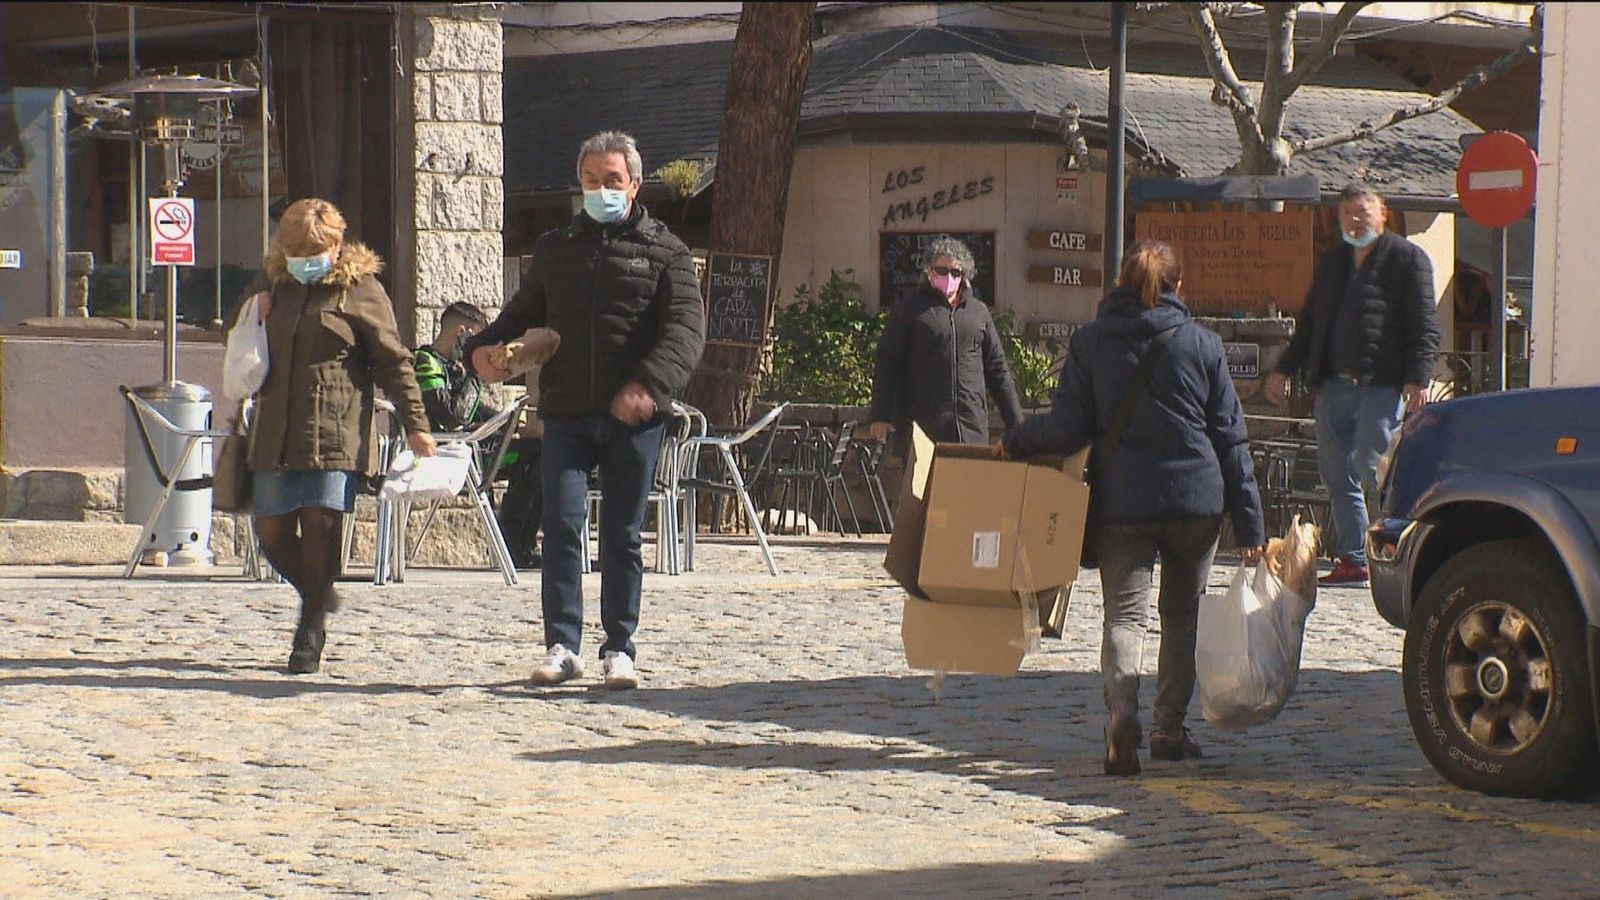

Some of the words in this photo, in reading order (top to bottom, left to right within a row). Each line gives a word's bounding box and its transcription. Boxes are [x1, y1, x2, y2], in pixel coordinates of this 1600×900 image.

[882, 166, 925, 193] LOS
[884, 177, 995, 227] ANGELES
[1050, 232, 1086, 250] CAFE
[1054, 267, 1082, 285] BAR
[714, 297, 757, 317] CARA
